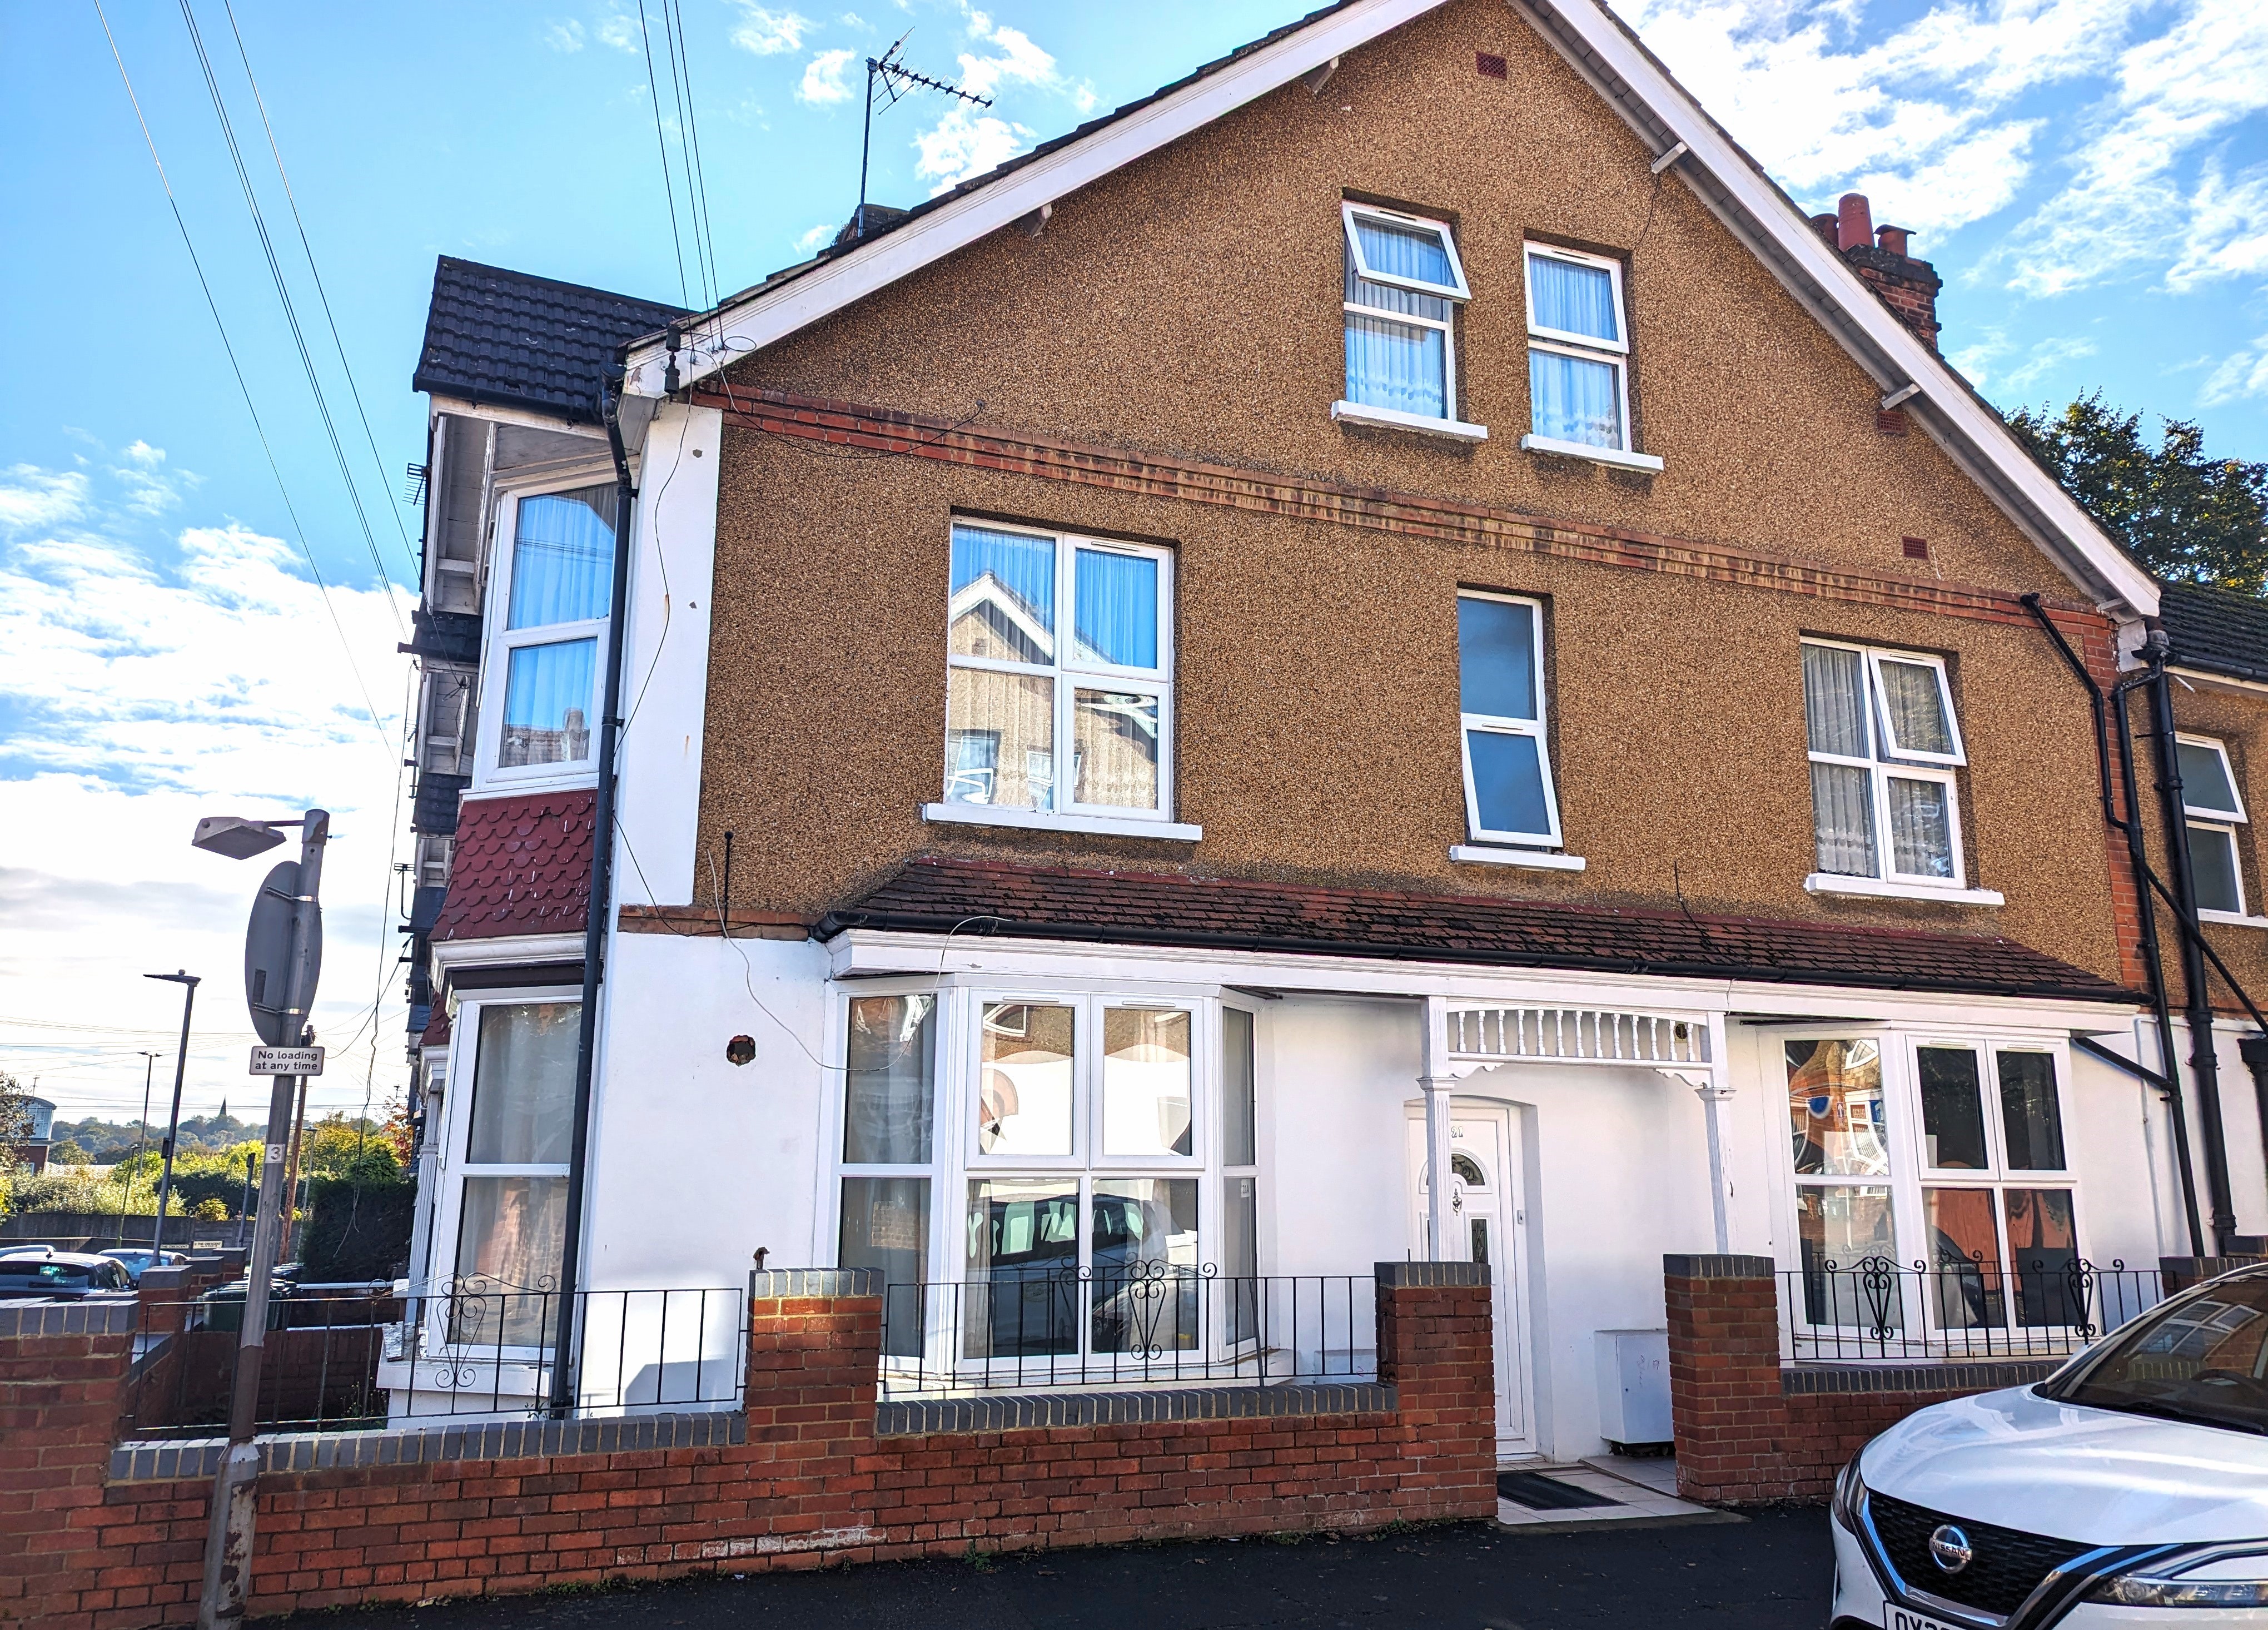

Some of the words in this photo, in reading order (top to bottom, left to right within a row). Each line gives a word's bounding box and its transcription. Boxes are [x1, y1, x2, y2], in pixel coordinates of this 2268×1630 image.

[258, 1051, 273, 1059] No
[277, 1051, 317, 1061] loading
[255, 1061, 267, 1070] at
[270, 1062, 290, 1071] any
[294, 1061, 317, 1070] time
[1451, 1126, 1464, 1138] 21
[270, 1146, 281, 1160] 3
[1932, 1542, 1965, 1557] NISSAN
